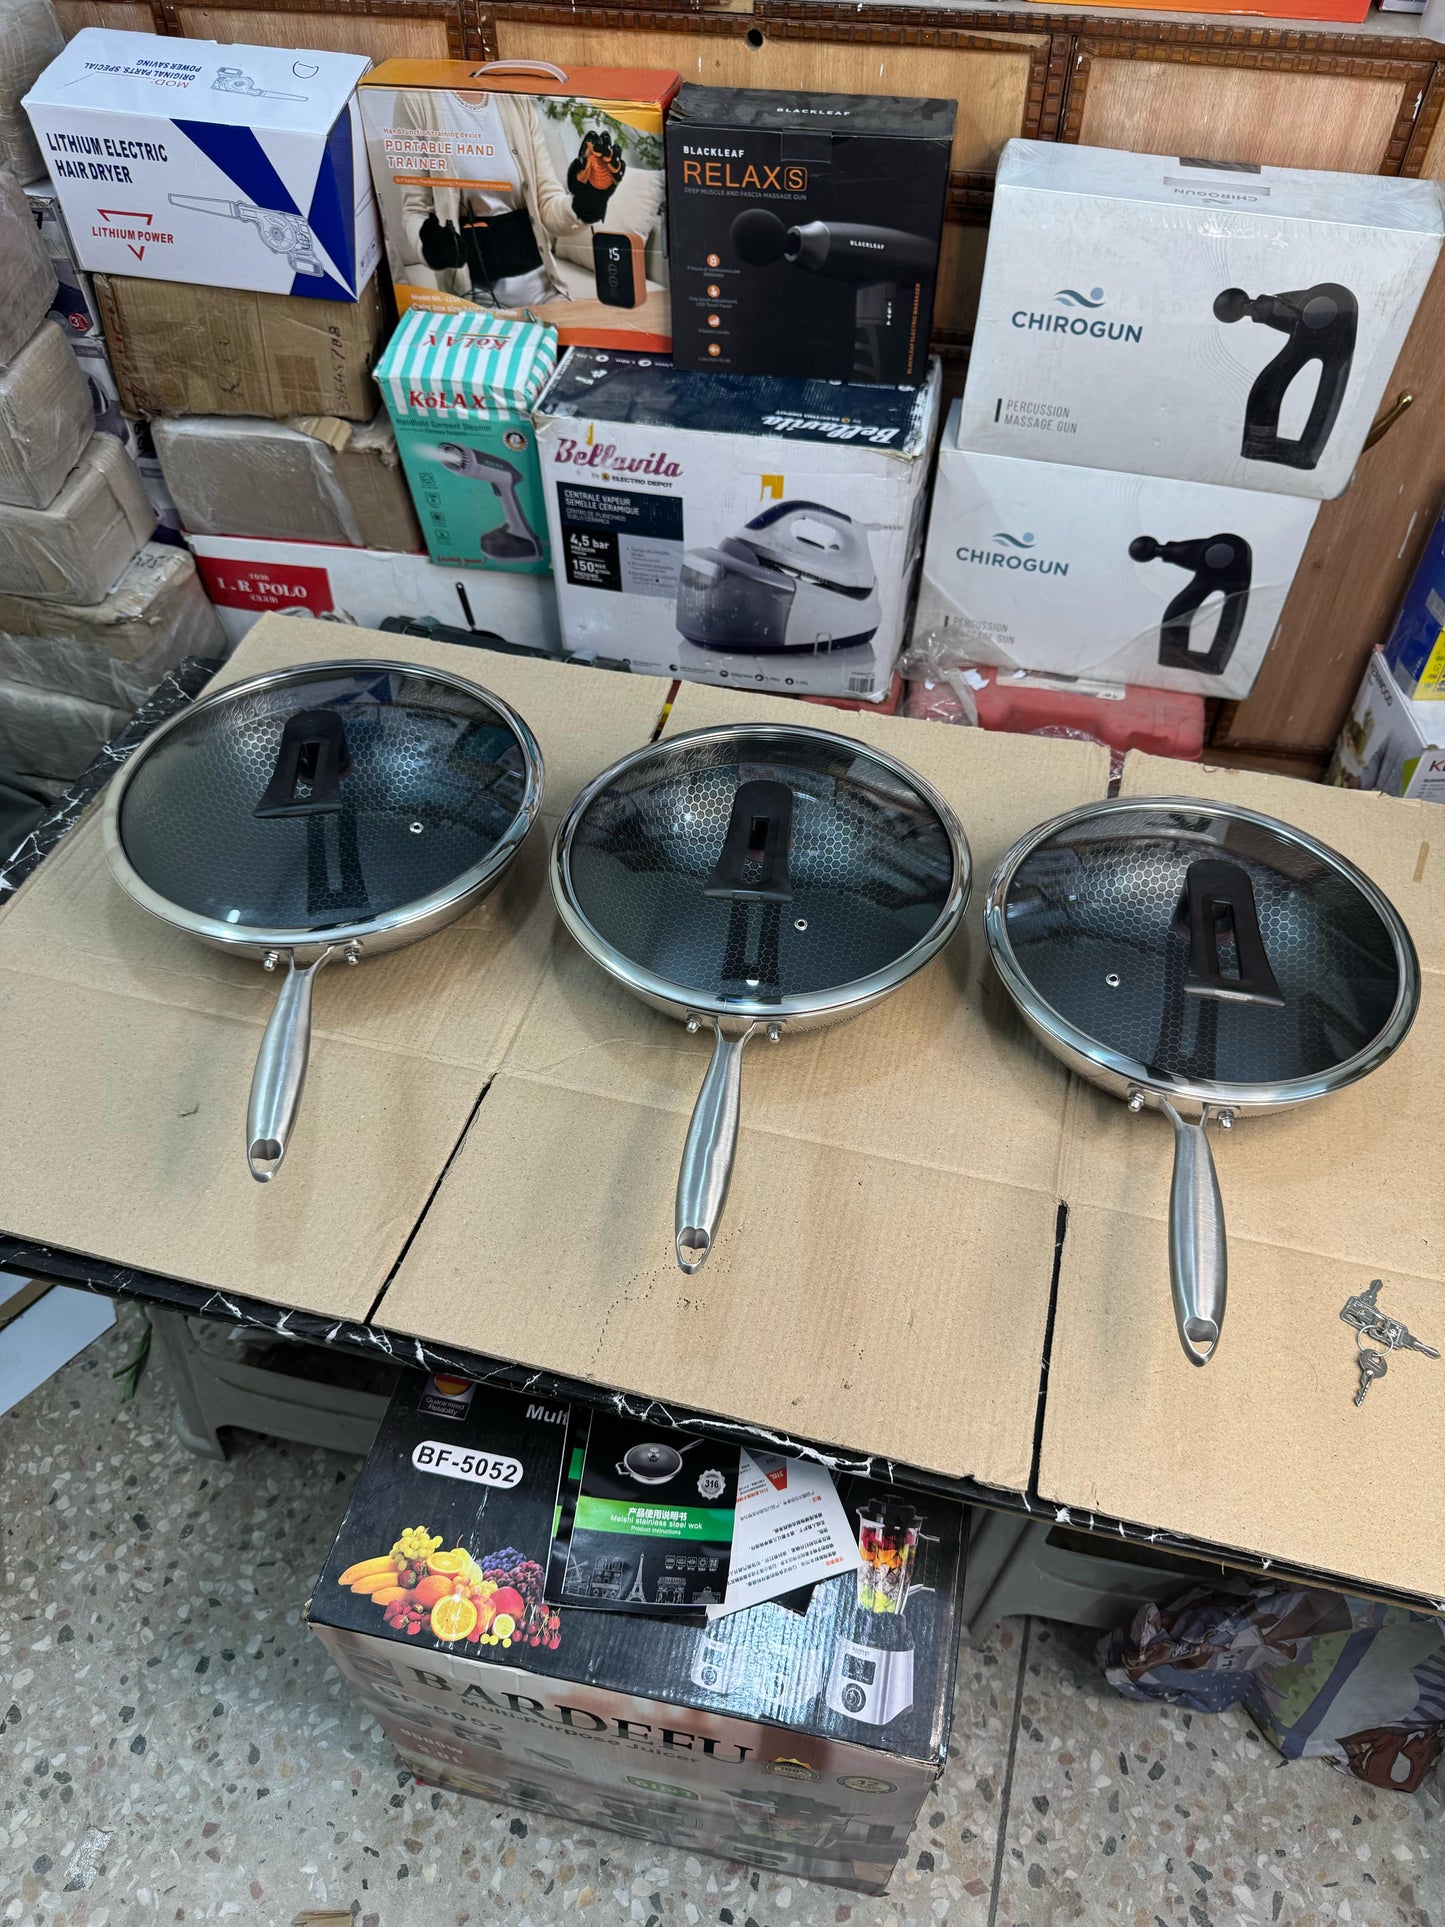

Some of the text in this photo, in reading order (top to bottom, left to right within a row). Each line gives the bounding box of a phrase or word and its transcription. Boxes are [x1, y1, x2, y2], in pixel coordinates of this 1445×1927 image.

[84, 62, 121, 72] SPECIAL
[136, 59, 202, 72] POWER SAVING
[154, 71, 196, 81] ORIGINAL
[776, 107, 851, 117] BLACKLEAF
[46, 132, 168, 162] LITHIUM ELECTRIC
[385, 139, 495, 157] PORTABLE HAND
[683, 146, 745, 158] BLACKLEAF
[388, 156, 447, 170] TRAINER
[55, 159, 133, 184] HAIR DRYER
[683, 160, 781, 190] RELAX
[684, 187, 699, 195] DEEP
[701, 188, 725, 197] MUSCLE
[740, 190, 763, 199] FASCIA
[763, 192, 792, 200] MASSAGE
[1174, 187, 1259, 203] CHIROGUN
[92, 226, 174, 244] LITHIUM POWER
[850, 240, 885, 250] BLACKLEAF
[1011, 310, 1144, 344] CHIROGUN
[1006, 399, 1070, 418] PERCUSSION
[762, 413, 900, 445] Bellavita
[1004, 415, 1078, 434] MASSAGE GUN
[554, 437, 684, 478] Bellavita
[612, 475, 646, 485] ELECTRO
[647, 480, 673, 488] DEPOT
[564, 489, 631, 506] CENTRALE VAPEUR
[565, 498, 598, 511] SEMELLE
[592, 539, 609, 550] bar
[572, 559, 594, 573] 150
[956, 547, 1069, 577] CHIROGUN
[258, 582, 307, 599] POLO
[425, 1396, 465, 1410] Guaranteed
[428, 1403, 458, 1416] Reliability
[417, 1445, 518, 1483] BF-5052
[704, 1479, 719, 1489] 316
[628, 1507, 688, 1522] 产品使用说明书
[631, 1525, 682, 1535] Product instructions
[635, 1517, 667, 1528] stainless
[669, 1520, 687, 1529] steel
[378, 1686, 506, 1734] BF-5052
[406, 1666, 754, 1764] BARDEFU
[624, 1740, 701, 1764] Juicer
